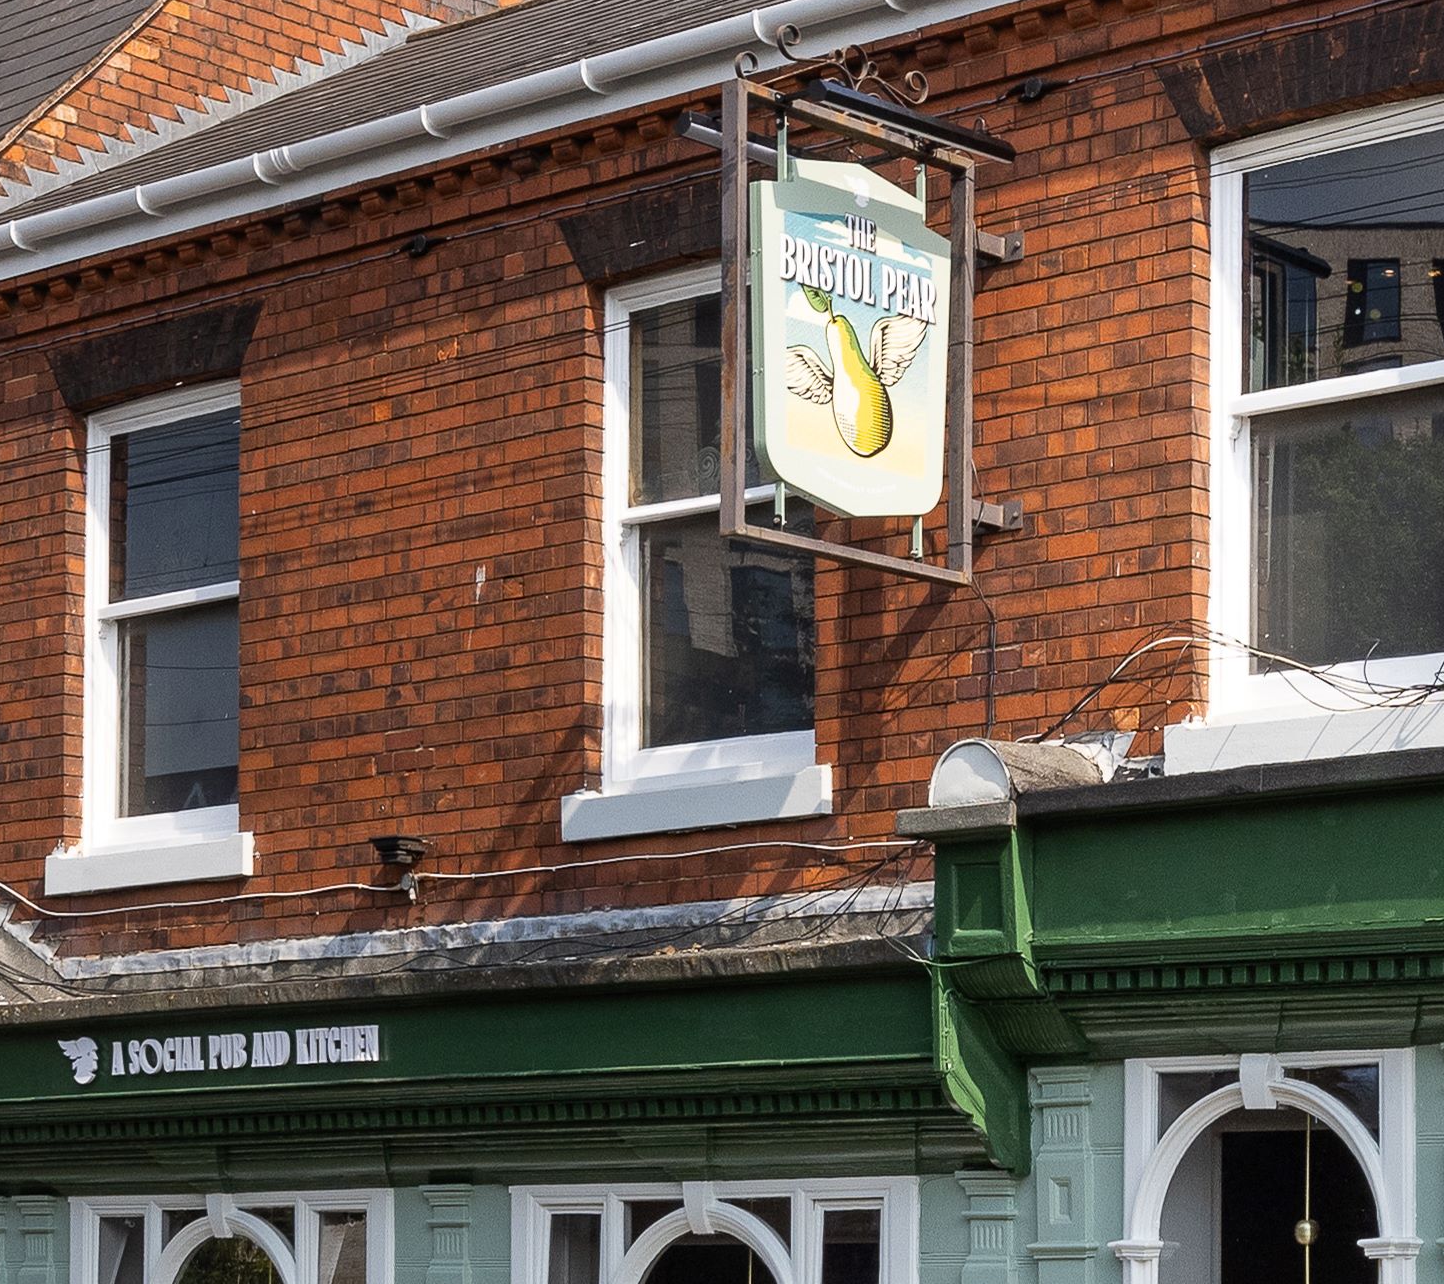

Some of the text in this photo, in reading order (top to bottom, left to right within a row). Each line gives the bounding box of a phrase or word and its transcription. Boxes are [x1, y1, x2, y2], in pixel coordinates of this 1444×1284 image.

[845, 213, 877, 253] THE
[779, 233, 937, 325] BRISTOL PEAR
[111, 1024, 380, 1075] A SOCIAL PUB AND KITCHEN
